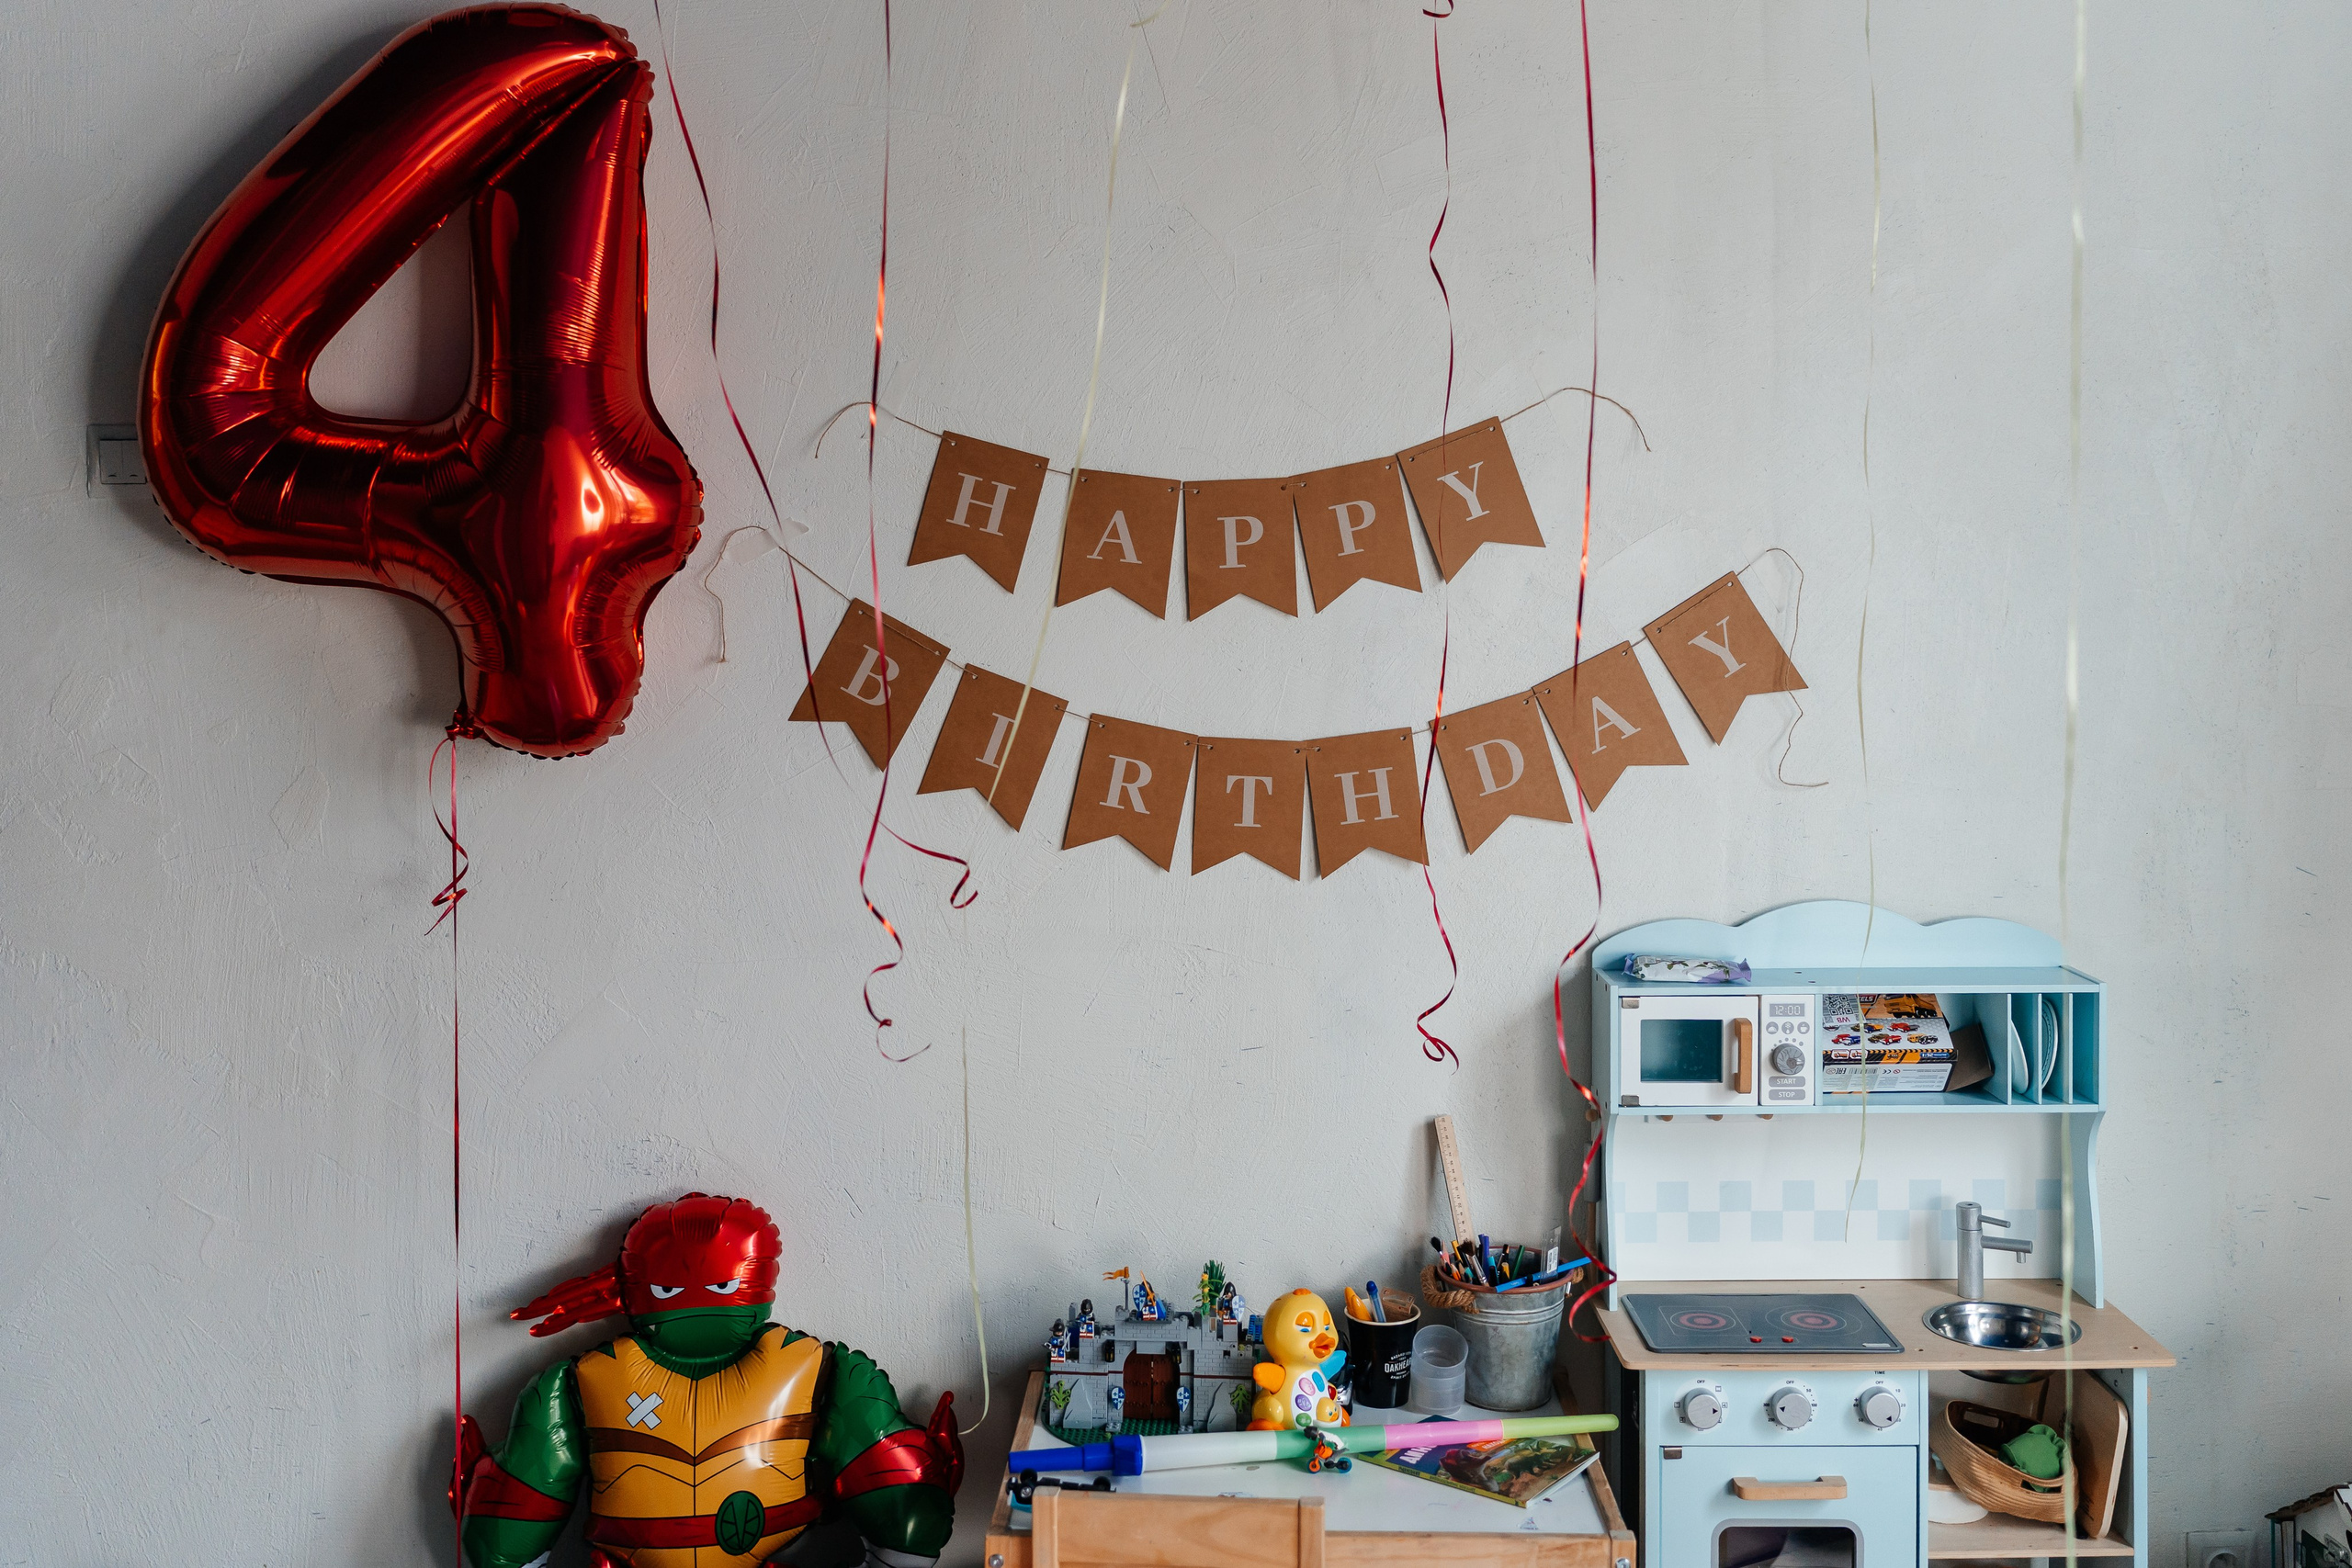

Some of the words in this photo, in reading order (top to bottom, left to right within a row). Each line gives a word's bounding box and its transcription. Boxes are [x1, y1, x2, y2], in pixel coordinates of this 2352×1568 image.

[945, 461, 1492, 570] HAPPY
[840, 615, 1747, 829] BIRTHDAY
[1774, 1005, 1801, 1016] 12:00
